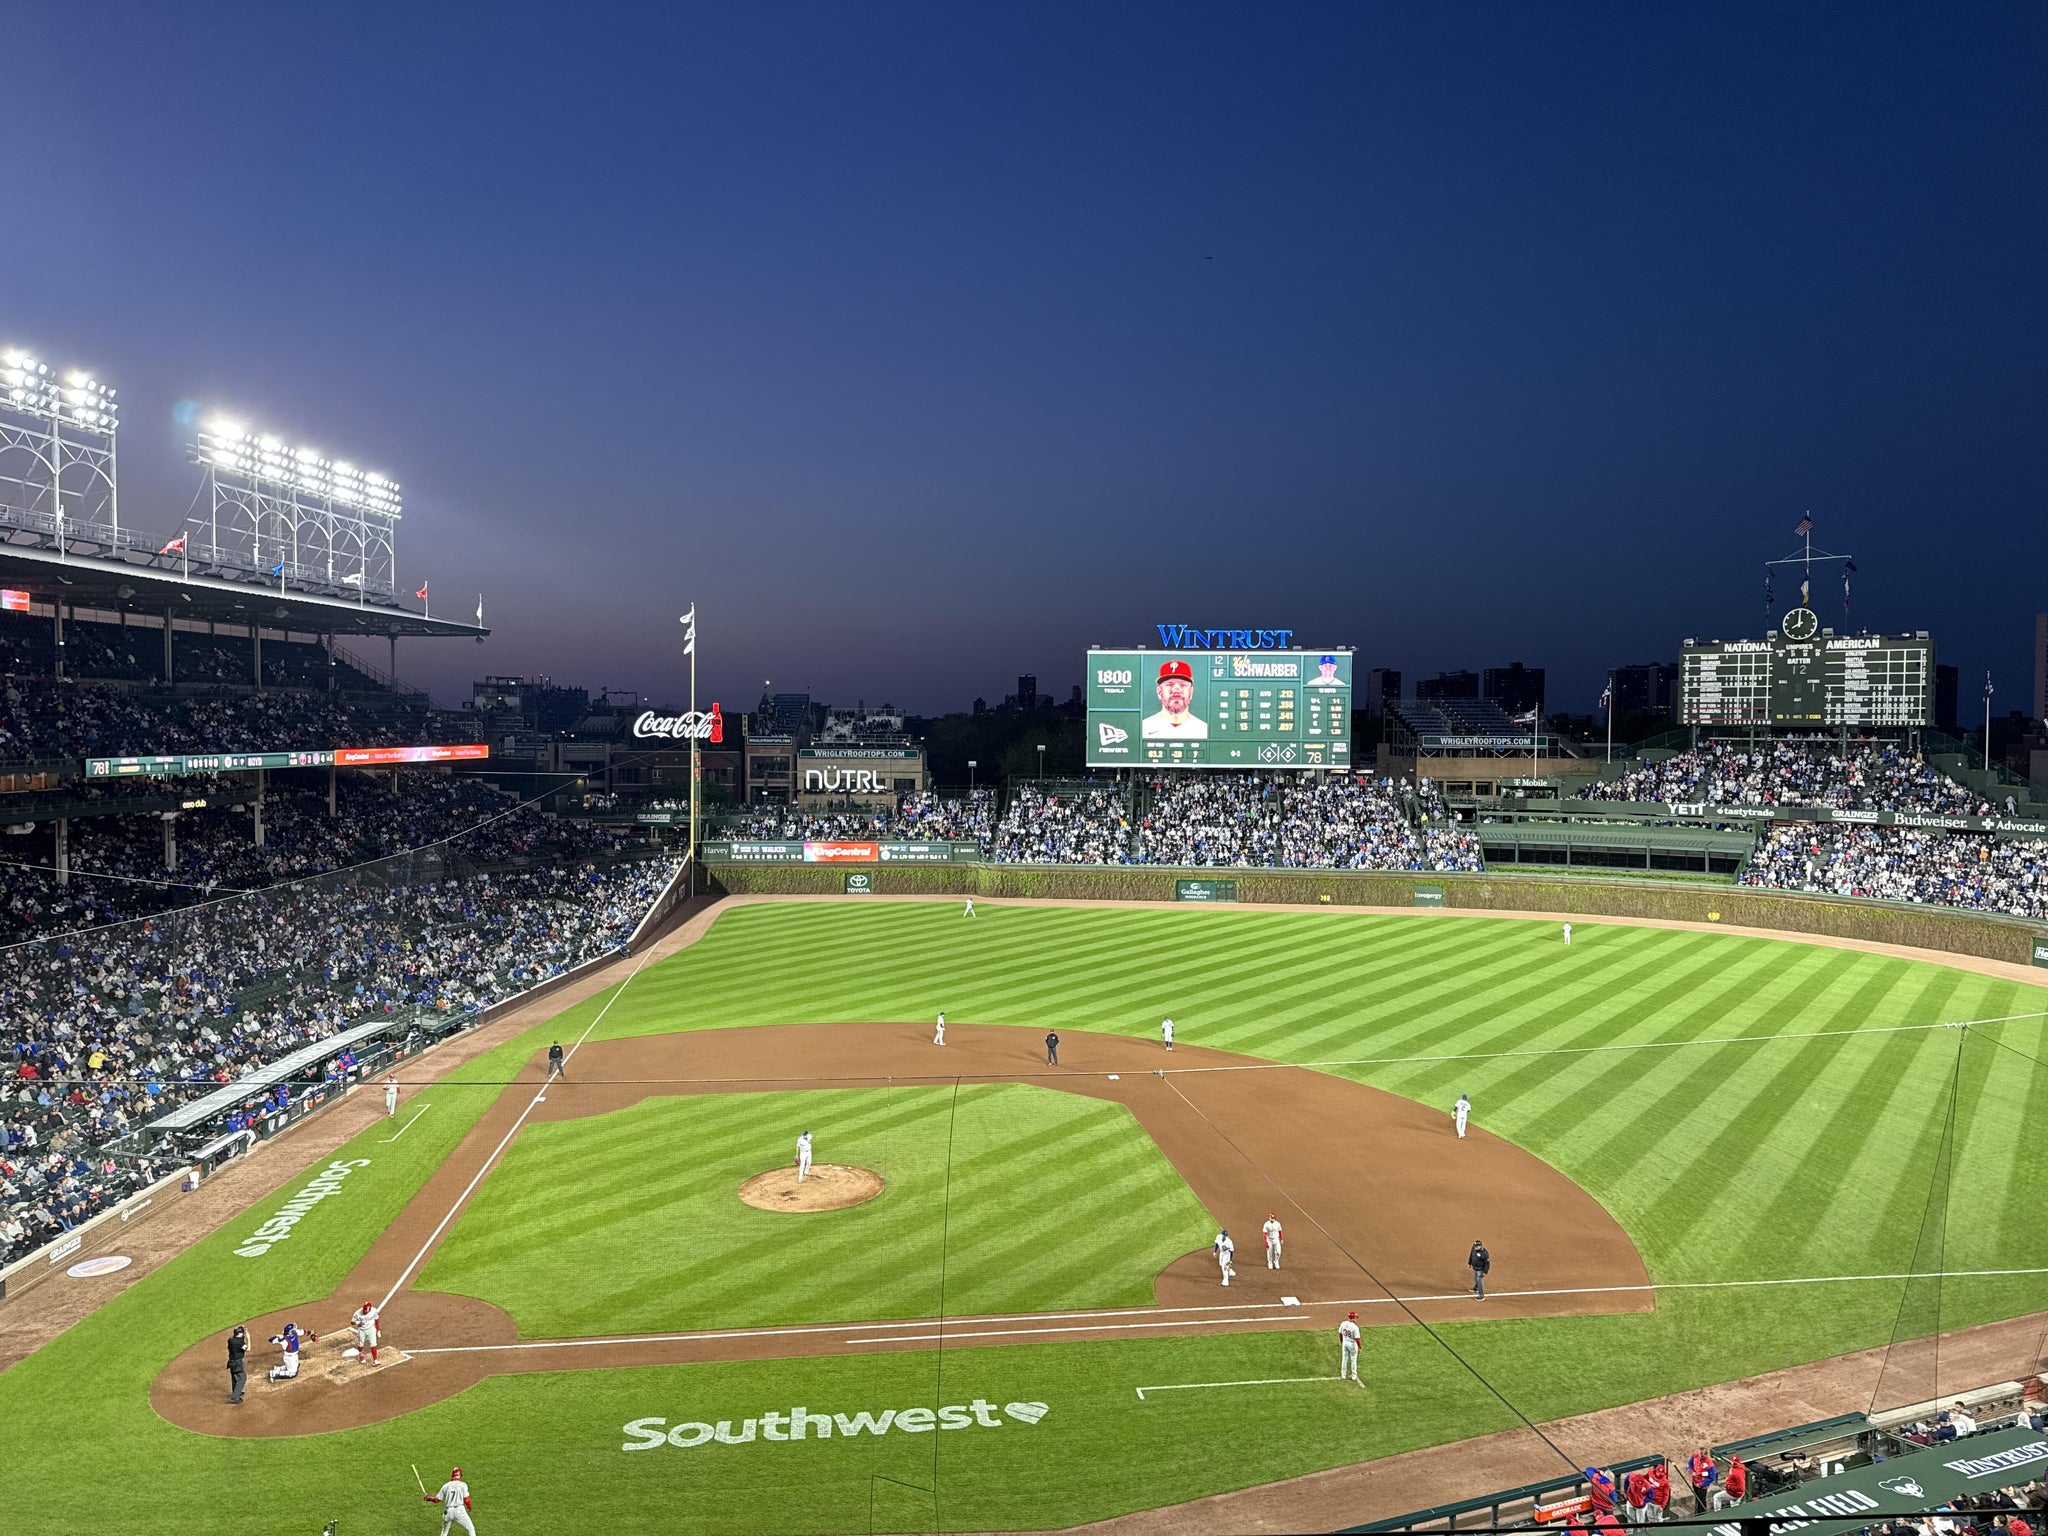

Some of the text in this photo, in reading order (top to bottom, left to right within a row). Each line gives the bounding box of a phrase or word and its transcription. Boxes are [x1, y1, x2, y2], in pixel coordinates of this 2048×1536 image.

[1156, 624, 1293, 649] WINTRUST
[1724, 643, 1773, 653] NATIONAL
[1826, 639, 1880, 649] AMERICAN
[1214, 656, 1224, 665] 12
[1234, 663, 1298, 677] SCHWARBER
[1097, 670, 1132, 684] 1800
[633, 711, 716, 739] Coca-Cola
[1307, 752, 1322, 763] 78
[93, 762, 105, 775] 78
[1667, 804, 1706, 816] YETI
[1724, 807, 1775, 817] tastytrade
[1831, 810, 1879, 819] GRAINGER
[1996, 820, 2046, 833] Advocate
[704, 847, 729, 855] Harvey
[1181, 888, 1210, 896] Gallagher
[242, 1159, 371, 1245] Southwest
[622, 1399, 1003, 1451] Southwest
[1942, 1441, 2048, 1475] WINTRUST
[451, 1491, 456, 1502] 7
[1806, 1490, 1879, 1516] FIELD
[1551, 1503, 1583, 1518] GATORADE
